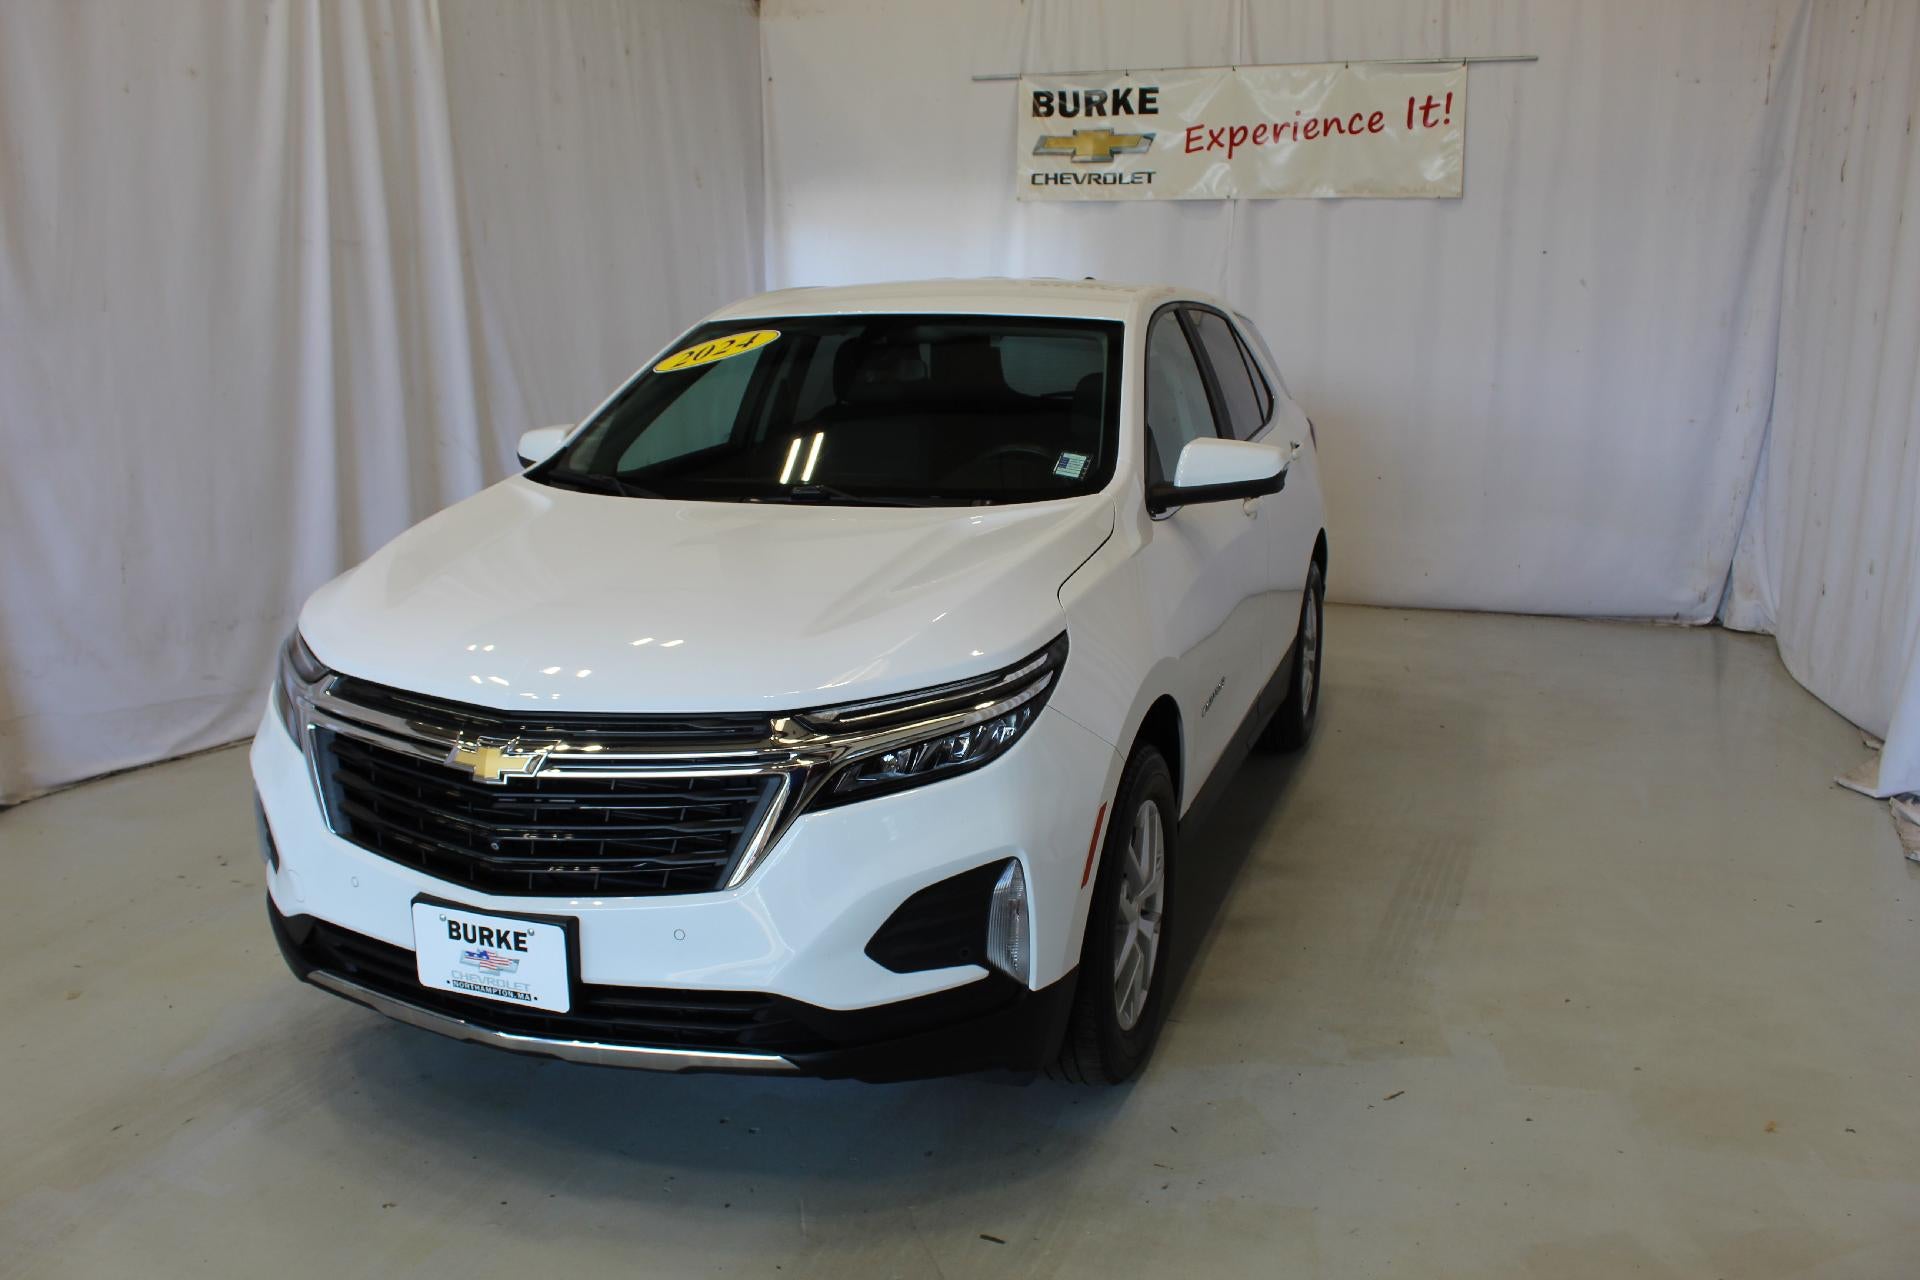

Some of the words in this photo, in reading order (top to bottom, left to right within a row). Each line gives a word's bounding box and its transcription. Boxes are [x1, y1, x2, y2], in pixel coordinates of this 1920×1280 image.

[1032, 86, 1160, 118] BURKE
[1185, 110, 1385, 160] Experience
[1406, 91, 1453, 130] It!
[1031, 171, 1157, 185] CHEVROLET
[672, 332, 761, 368] 2024
[447, 920, 528, 953] BURKE
[451, 970, 531, 991] CHEVROLET
